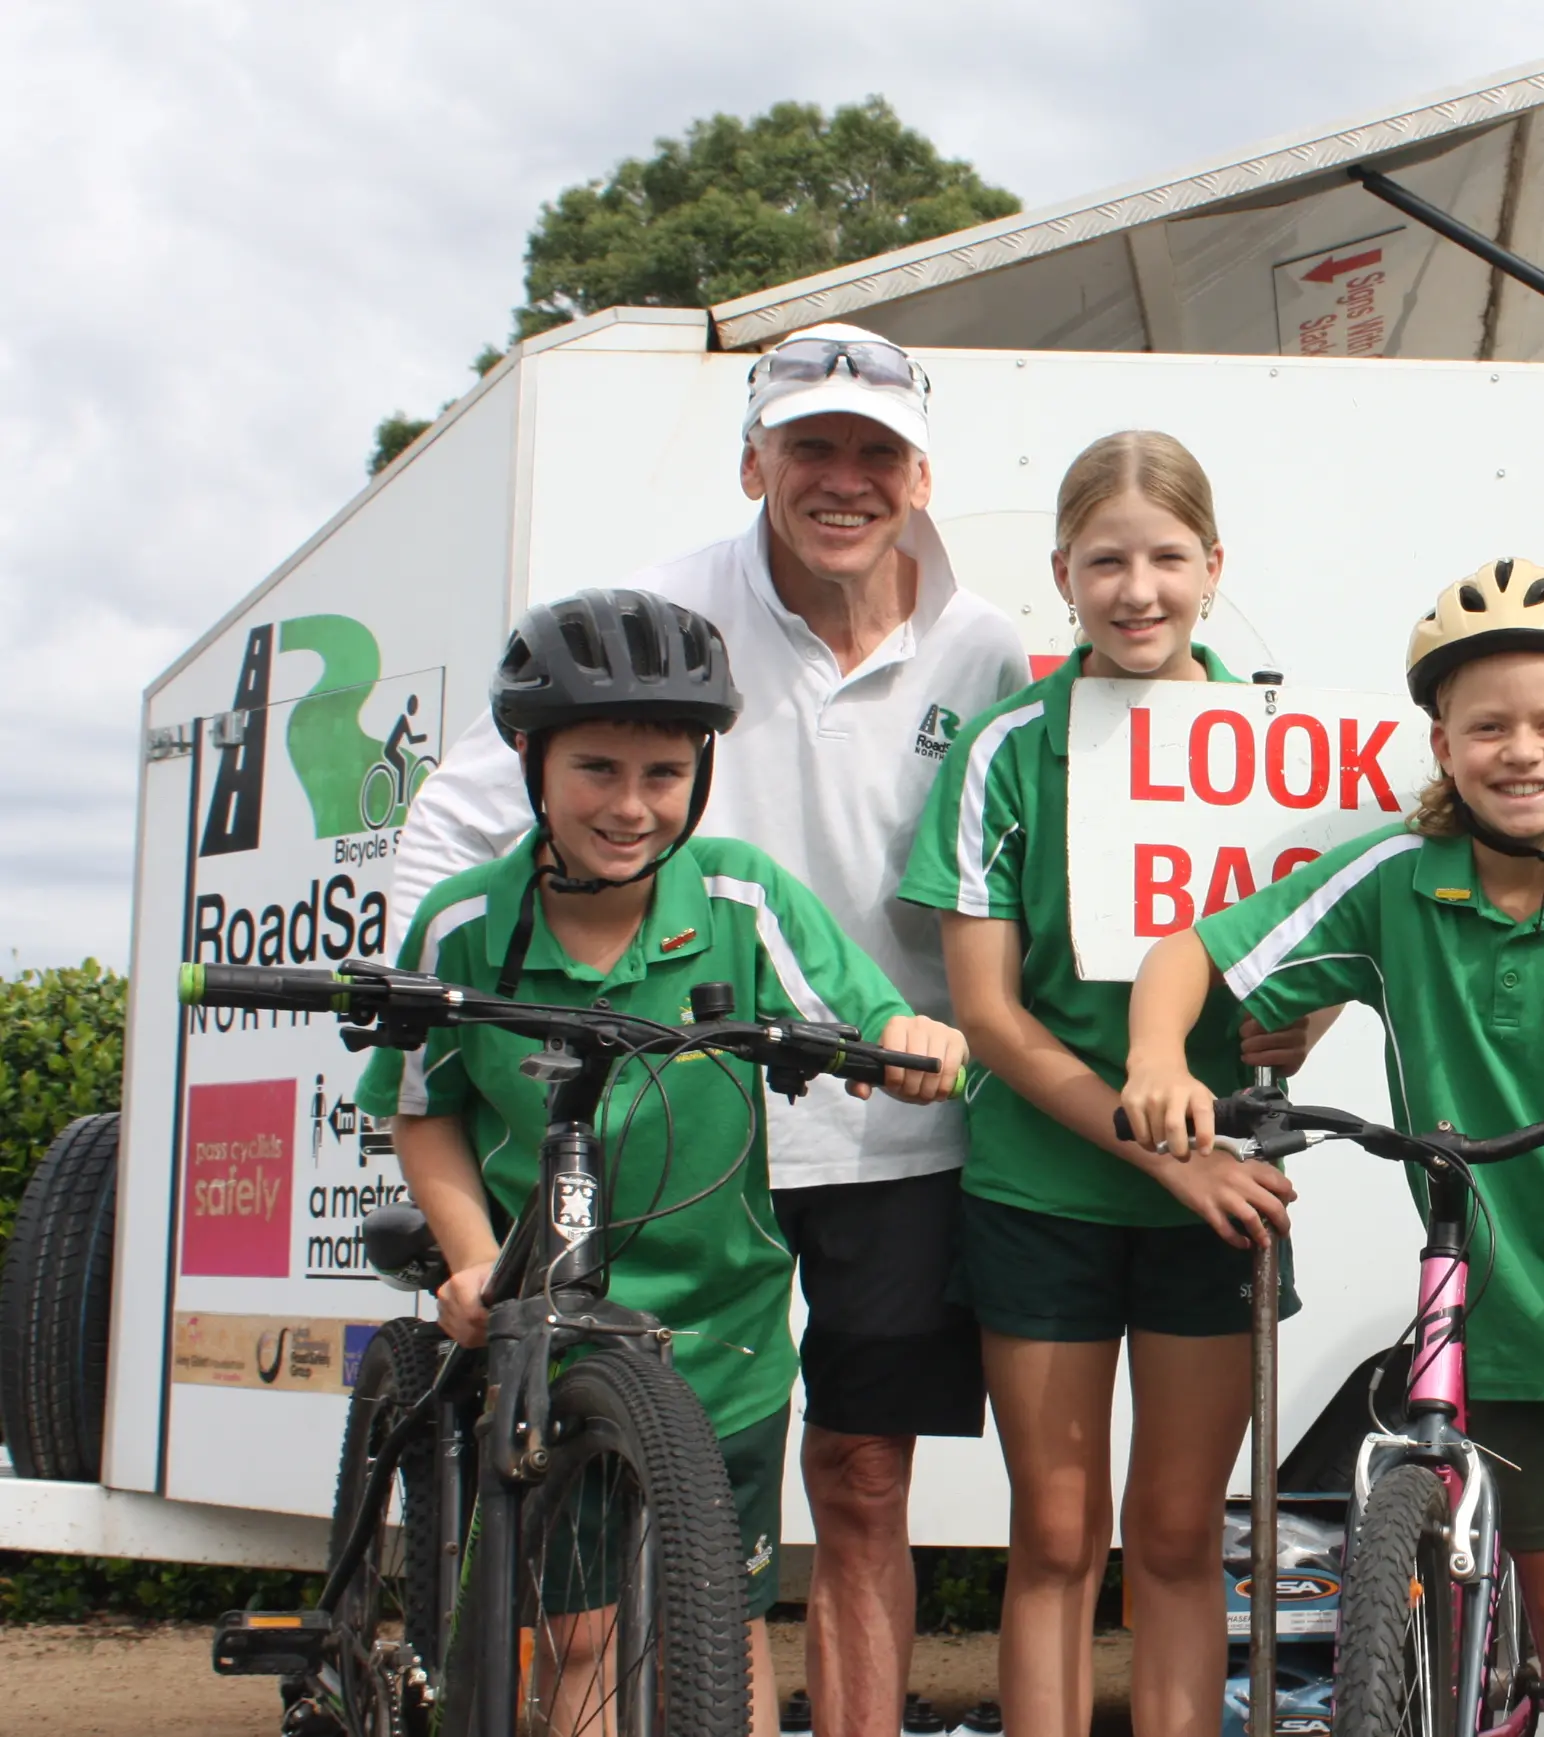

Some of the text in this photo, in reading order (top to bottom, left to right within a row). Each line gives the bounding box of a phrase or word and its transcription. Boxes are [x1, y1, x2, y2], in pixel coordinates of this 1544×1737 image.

[1336, 271, 1385, 319] Signs
[914, 746, 945, 761] NORTH
[916, 733, 951, 754] Road
[1129, 707, 1402, 813] LOOK
[335, 833, 388, 868] Bicycle
[1133, 843, 1322, 938] BA
[193, 873, 387, 966] RoadSa
[195, 1142, 227, 1165] pass
[195, 1164, 282, 1223] safely
[309, 1185, 327, 1218] a
[1275, 1581, 1322, 1594] SA
[1228, 1614, 1251, 1623] HASE
[1275, 1719, 1331, 1733] SA
